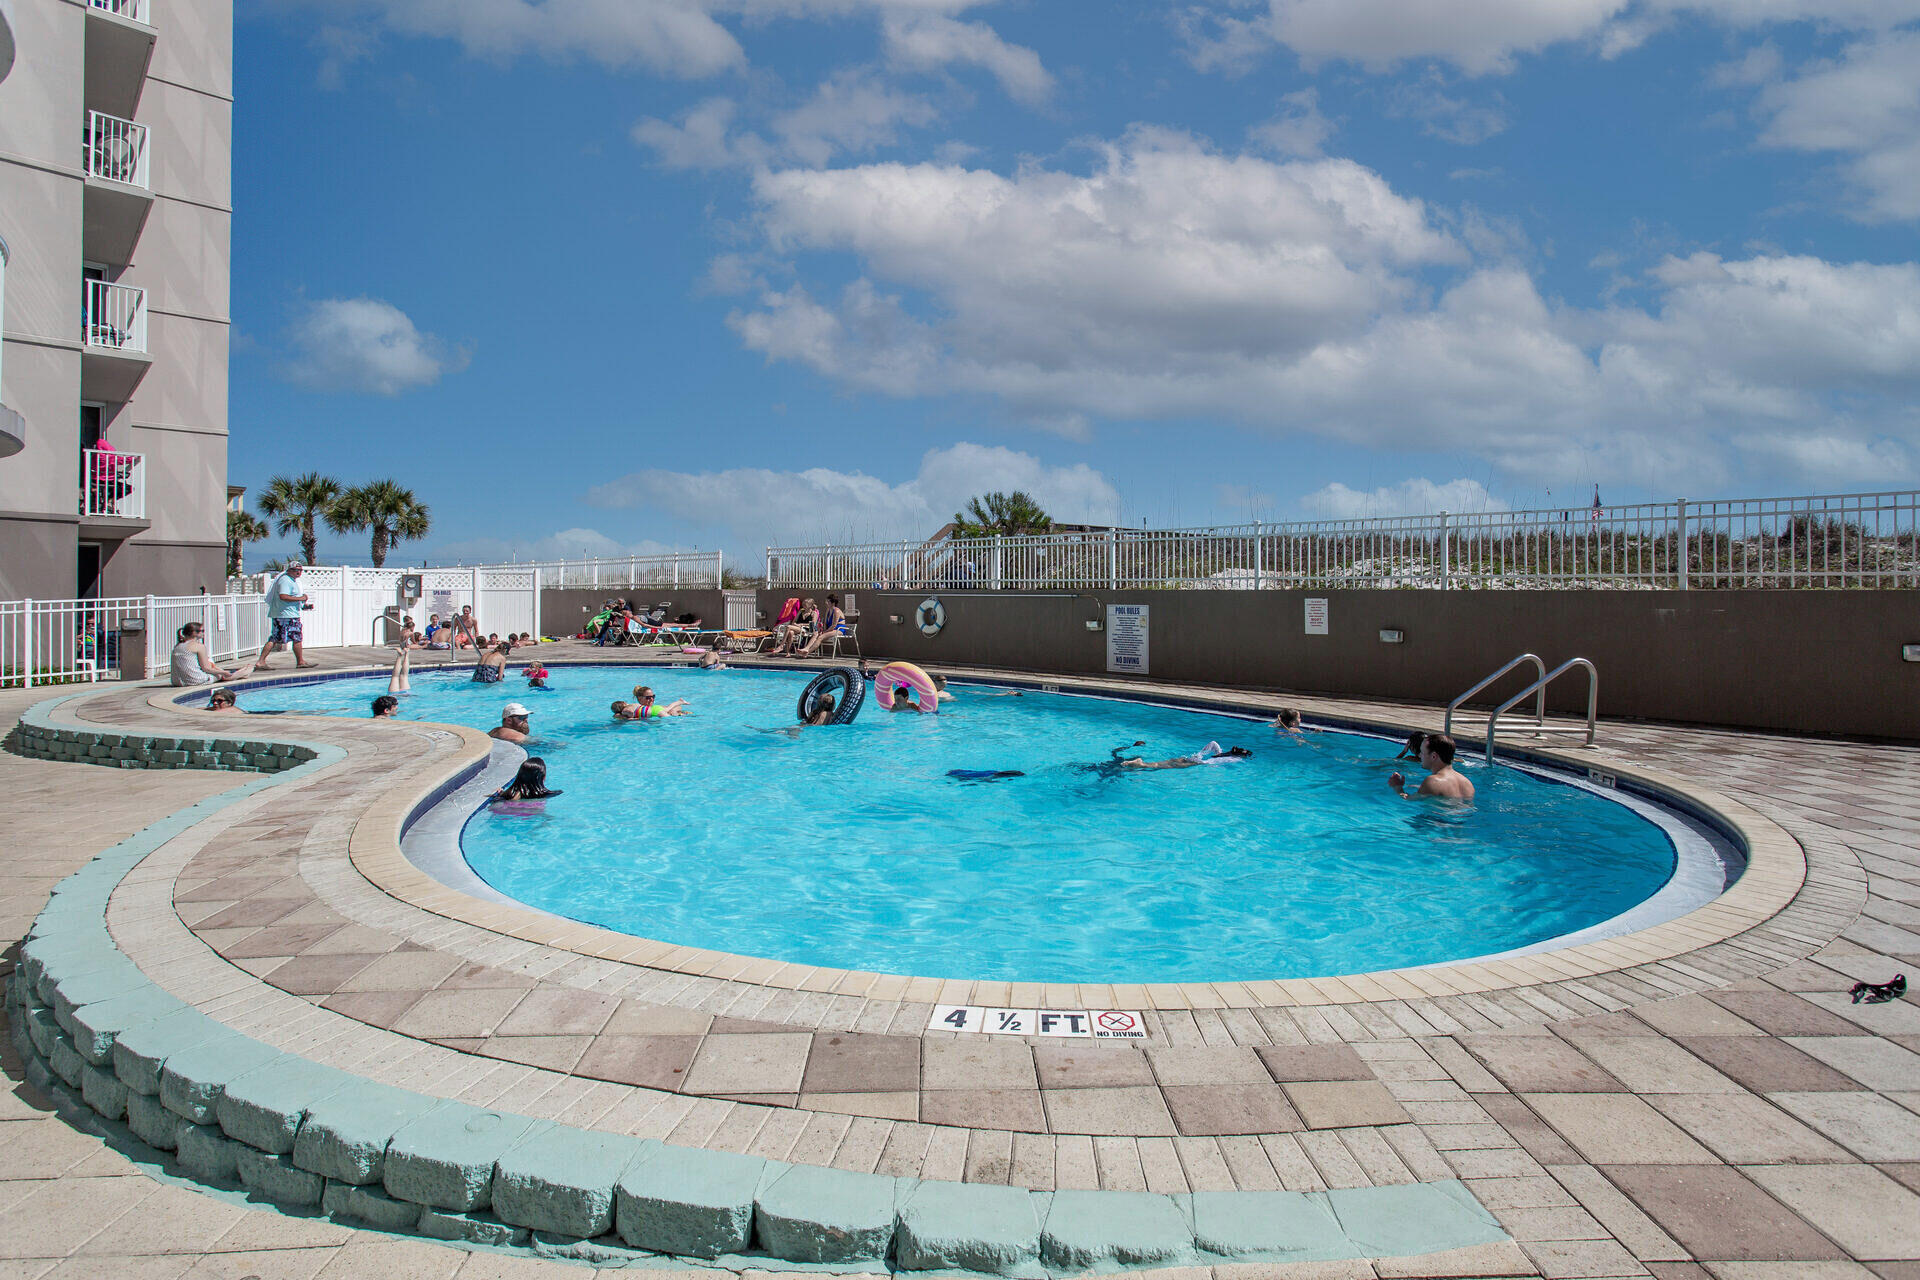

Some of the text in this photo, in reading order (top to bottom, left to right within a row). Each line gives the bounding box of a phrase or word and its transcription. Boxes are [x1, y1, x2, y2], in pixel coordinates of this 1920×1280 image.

[1115, 606, 1140, 615] POOL RULES
[1115, 656, 1140, 665] NO DIVING
[944, 1009, 967, 1027] 4
[1041, 1013, 1087, 1033] FT.
